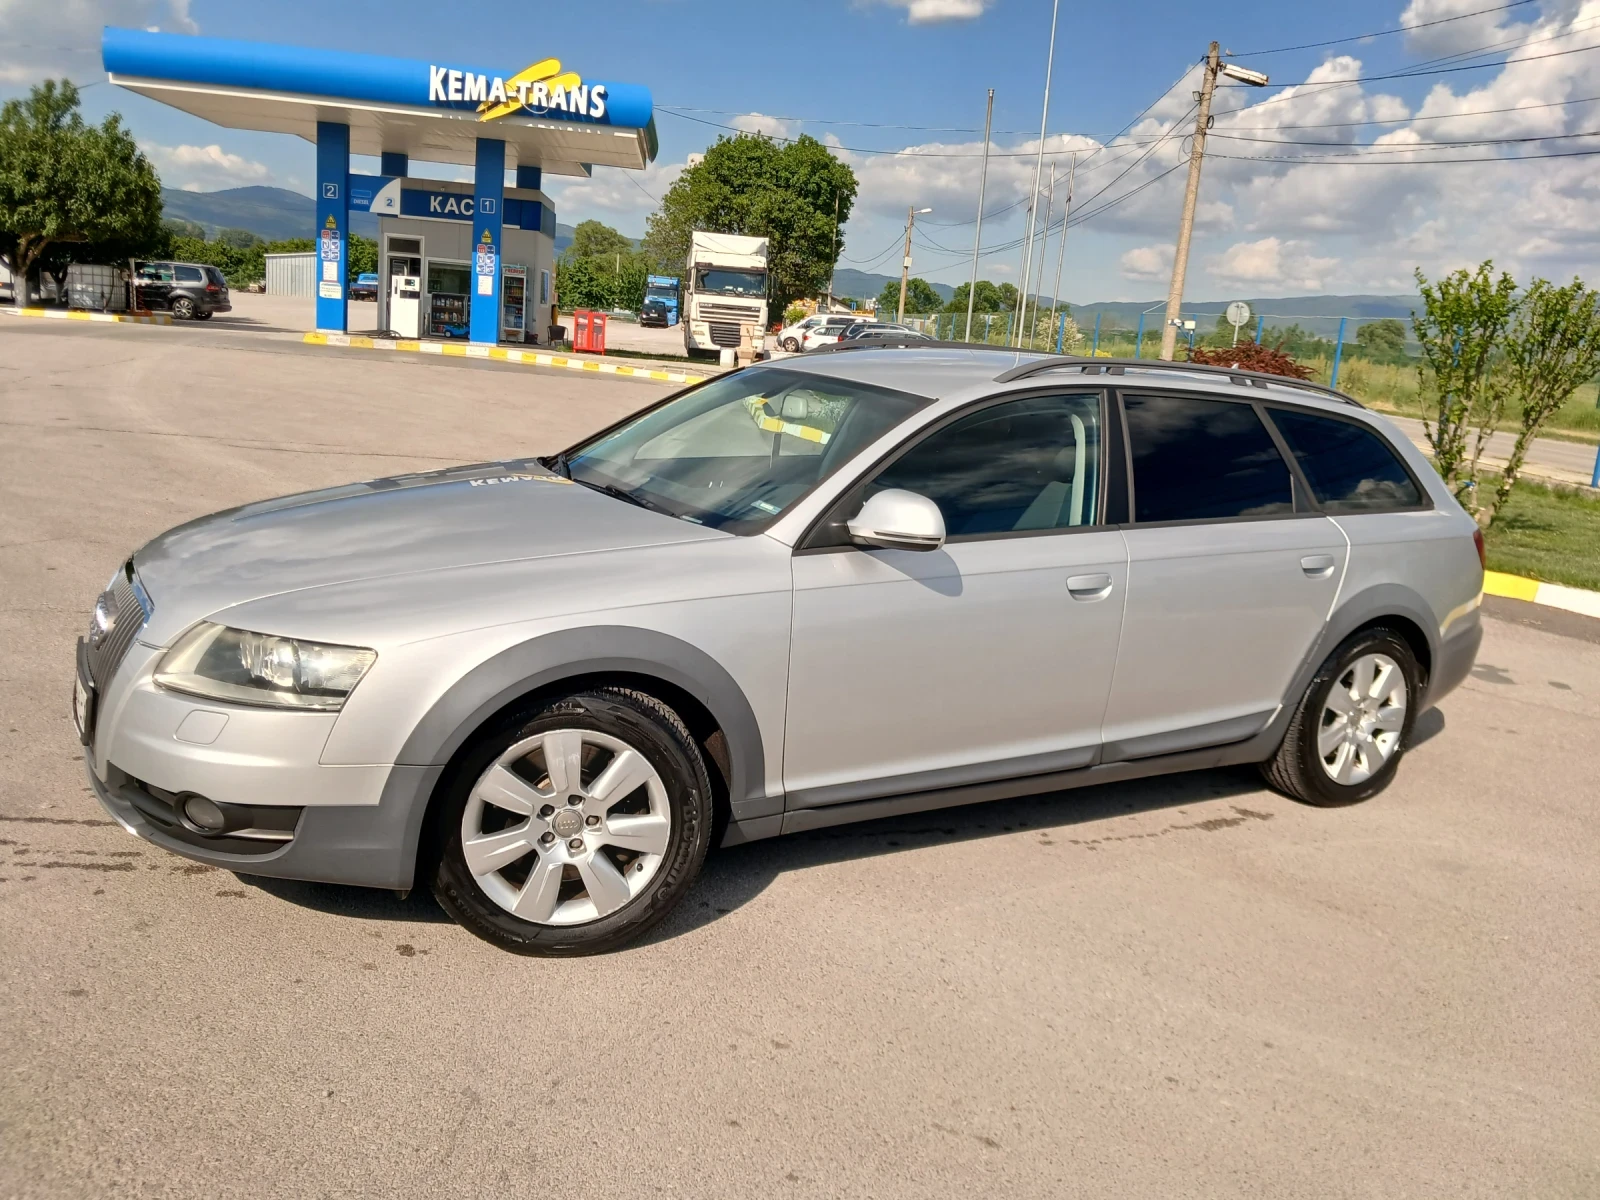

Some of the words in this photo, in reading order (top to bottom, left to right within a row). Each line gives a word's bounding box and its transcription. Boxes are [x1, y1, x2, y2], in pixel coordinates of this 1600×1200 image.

[429, 65, 605, 118] KEMA-TRANS
[326, 185, 335, 197] 2
[386, 198, 393, 207] 2
